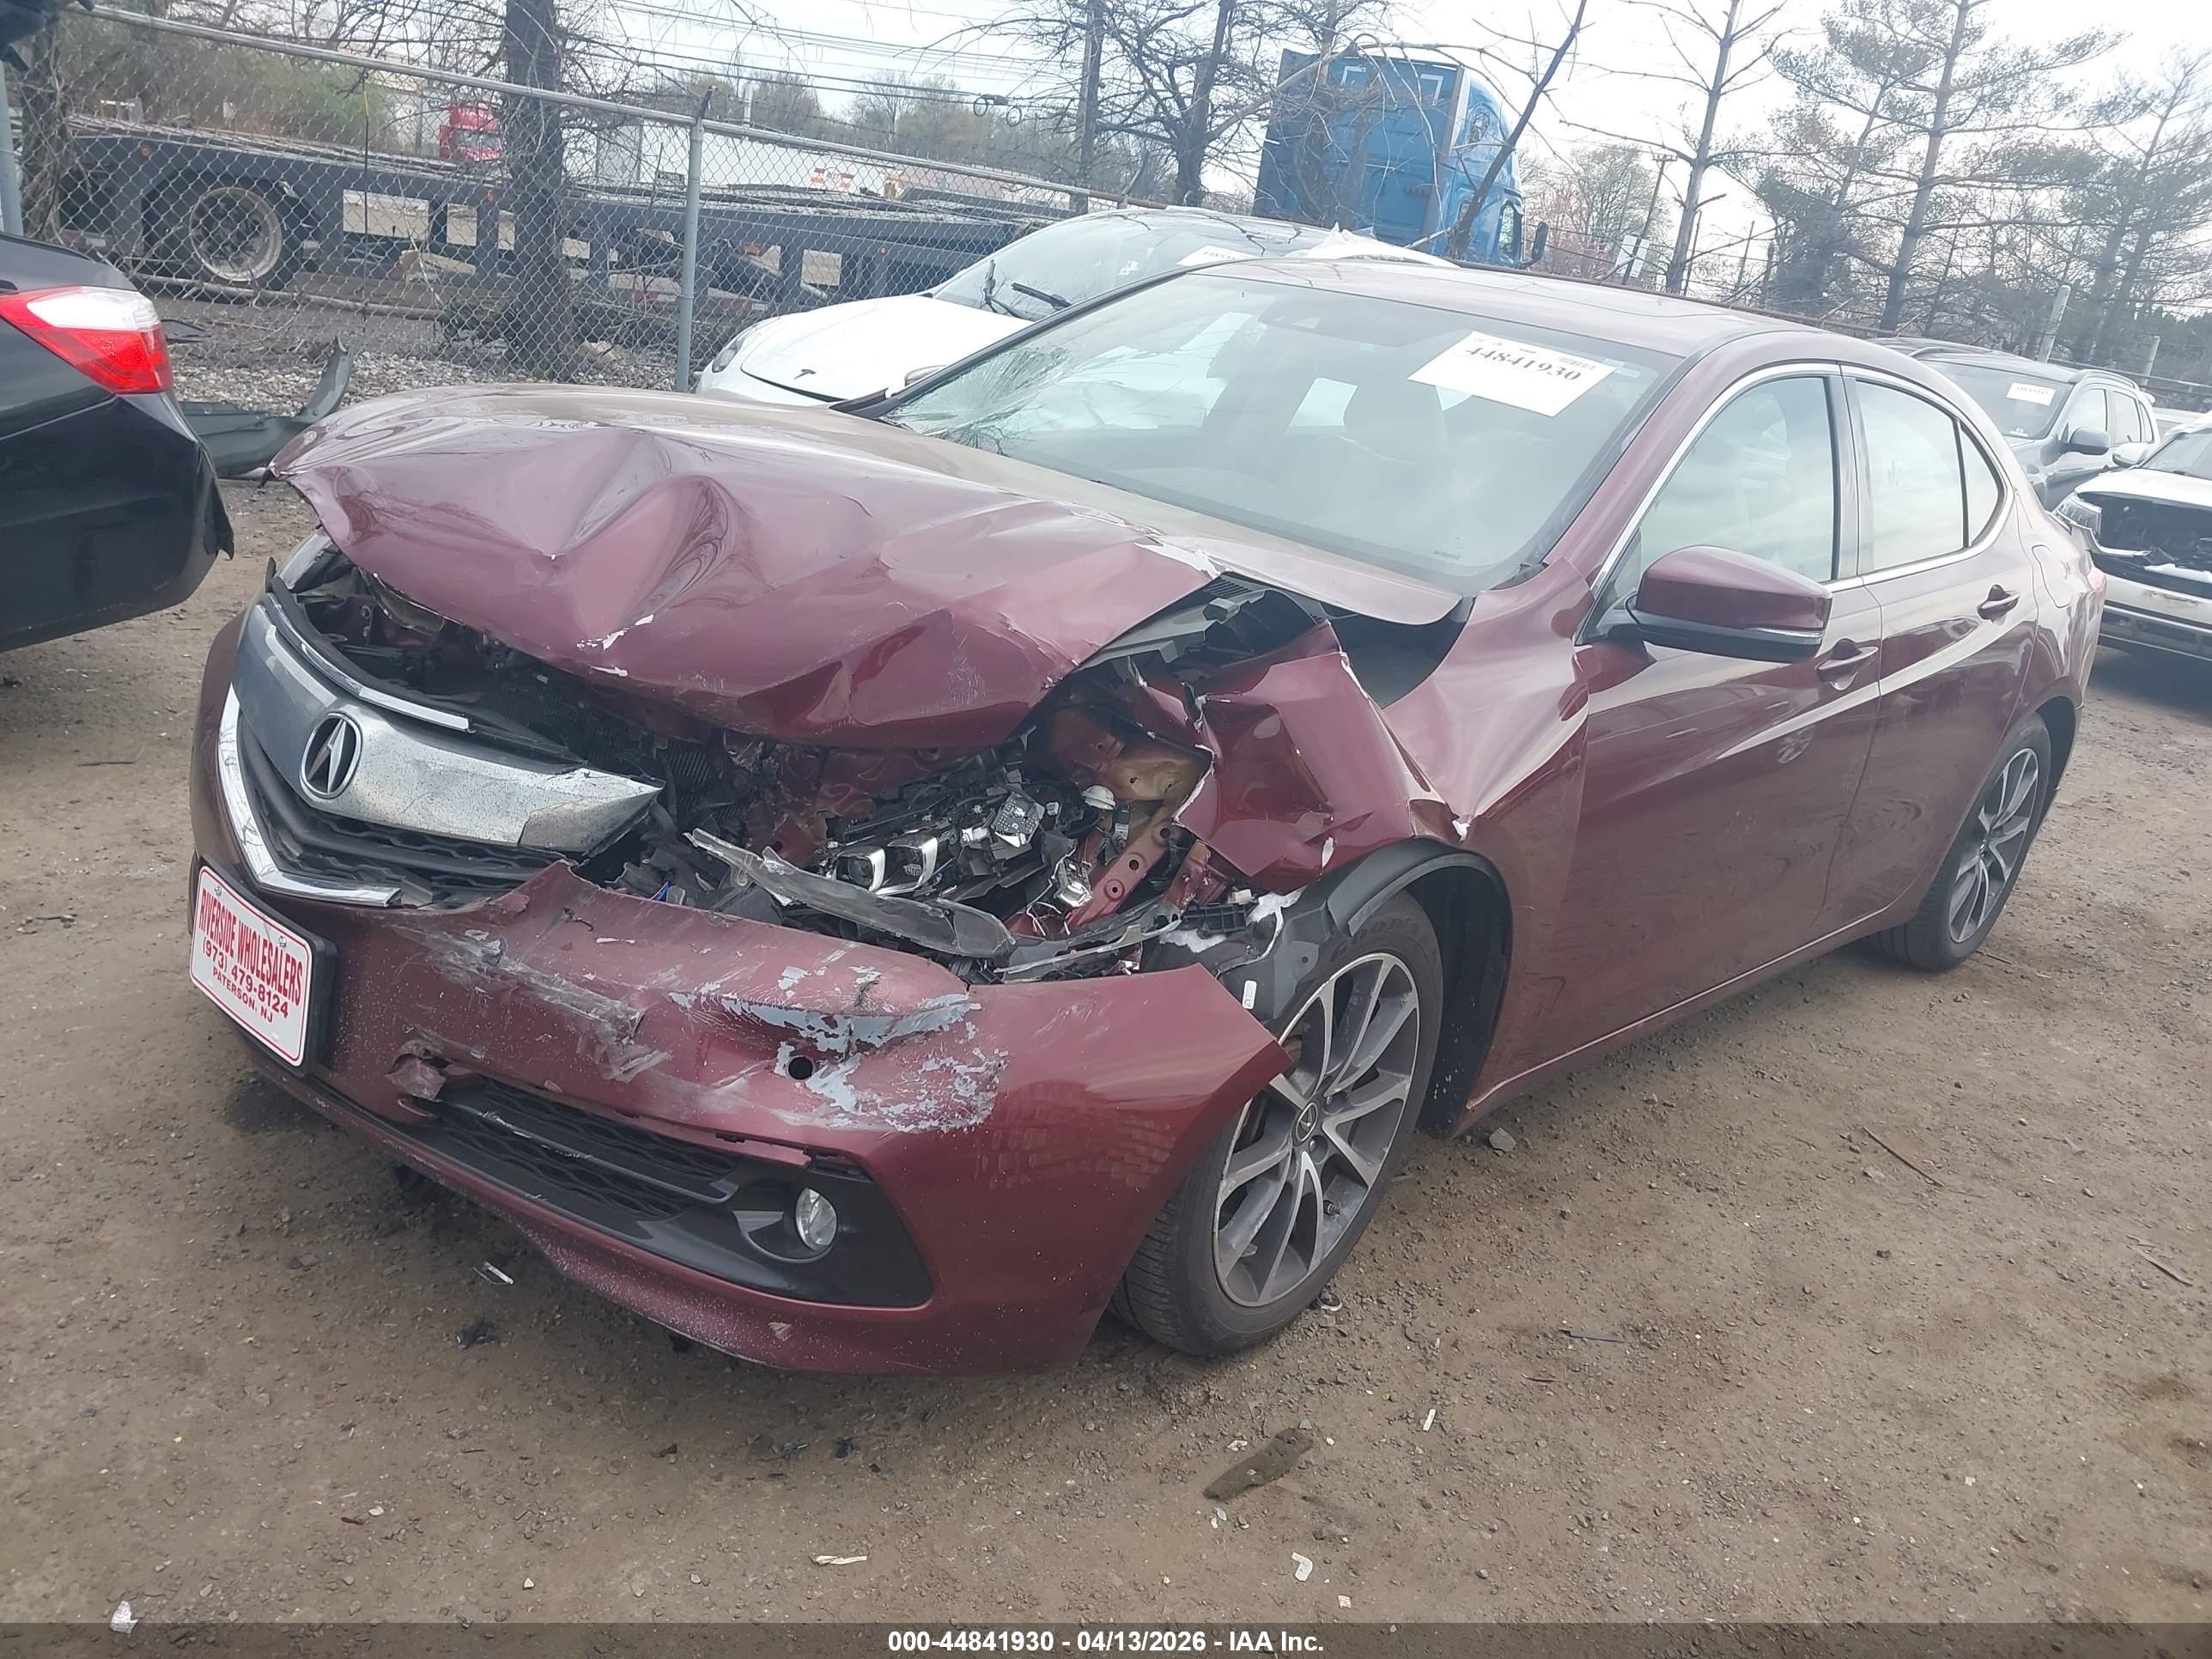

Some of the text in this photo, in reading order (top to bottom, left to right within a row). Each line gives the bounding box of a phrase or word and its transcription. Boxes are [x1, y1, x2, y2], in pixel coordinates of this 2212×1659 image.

[1465, 347, 1582, 380] 44841930
[198, 888, 303, 1006] RIVERSIDE WHOLESALERS
[202, 935, 289, 1019] (973) 479-8124
[260, 1006, 274, 1024] NJ
